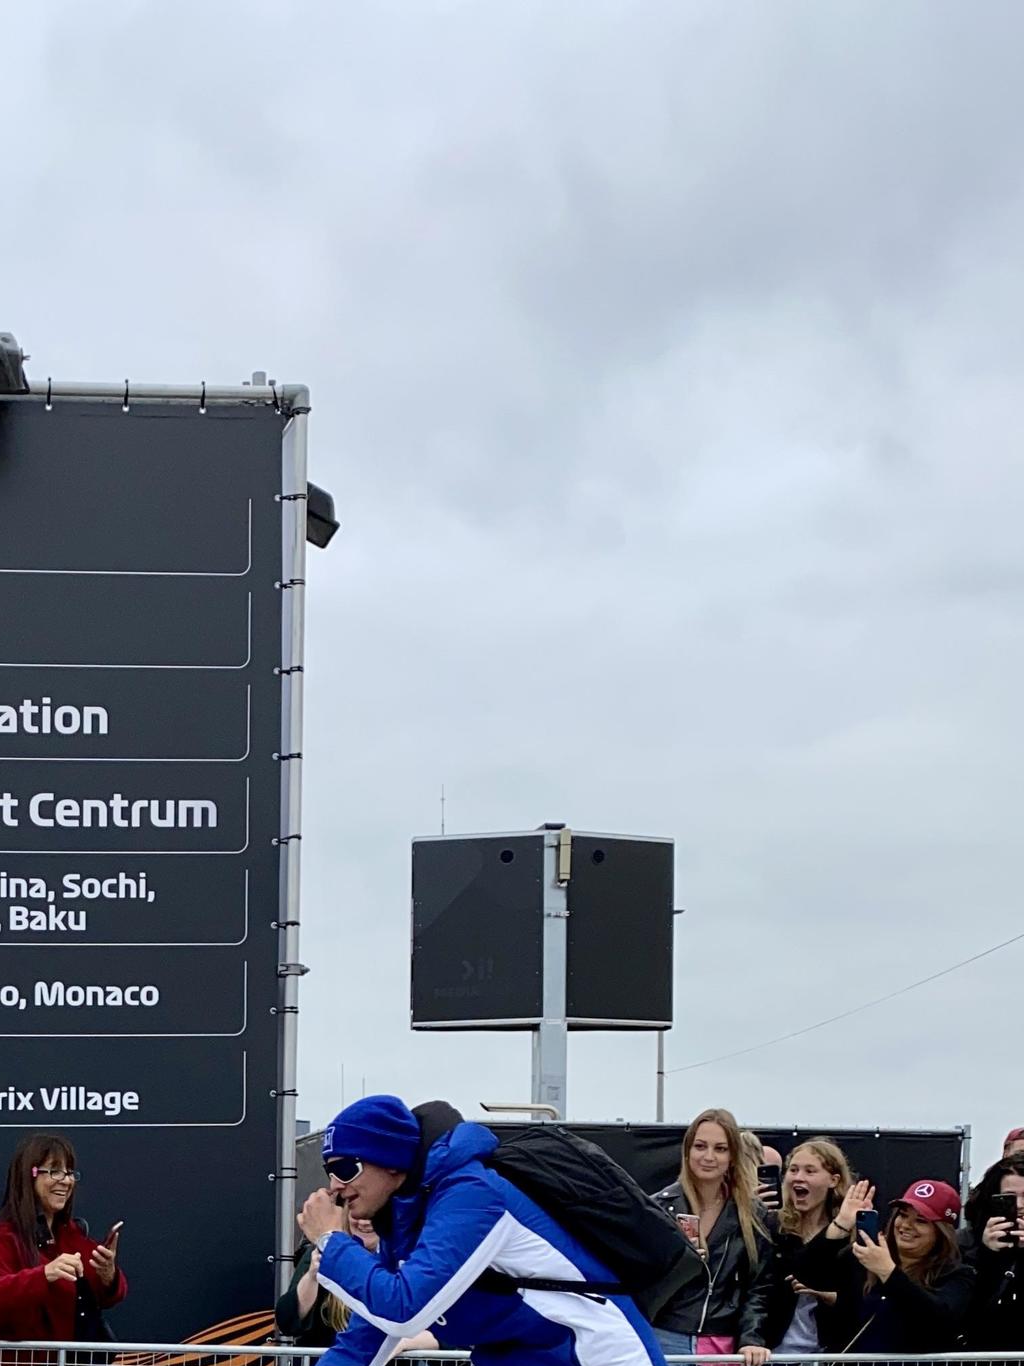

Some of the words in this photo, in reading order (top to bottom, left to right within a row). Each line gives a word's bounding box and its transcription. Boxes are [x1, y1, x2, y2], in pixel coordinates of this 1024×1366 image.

[29, 792, 217, 828] Centrum
[62, 872, 155, 903] Sochi,
[9, 906, 87, 931] Baku
[34, 981, 160, 1007] Monaco
[39, 1086, 140, 1116] Village
